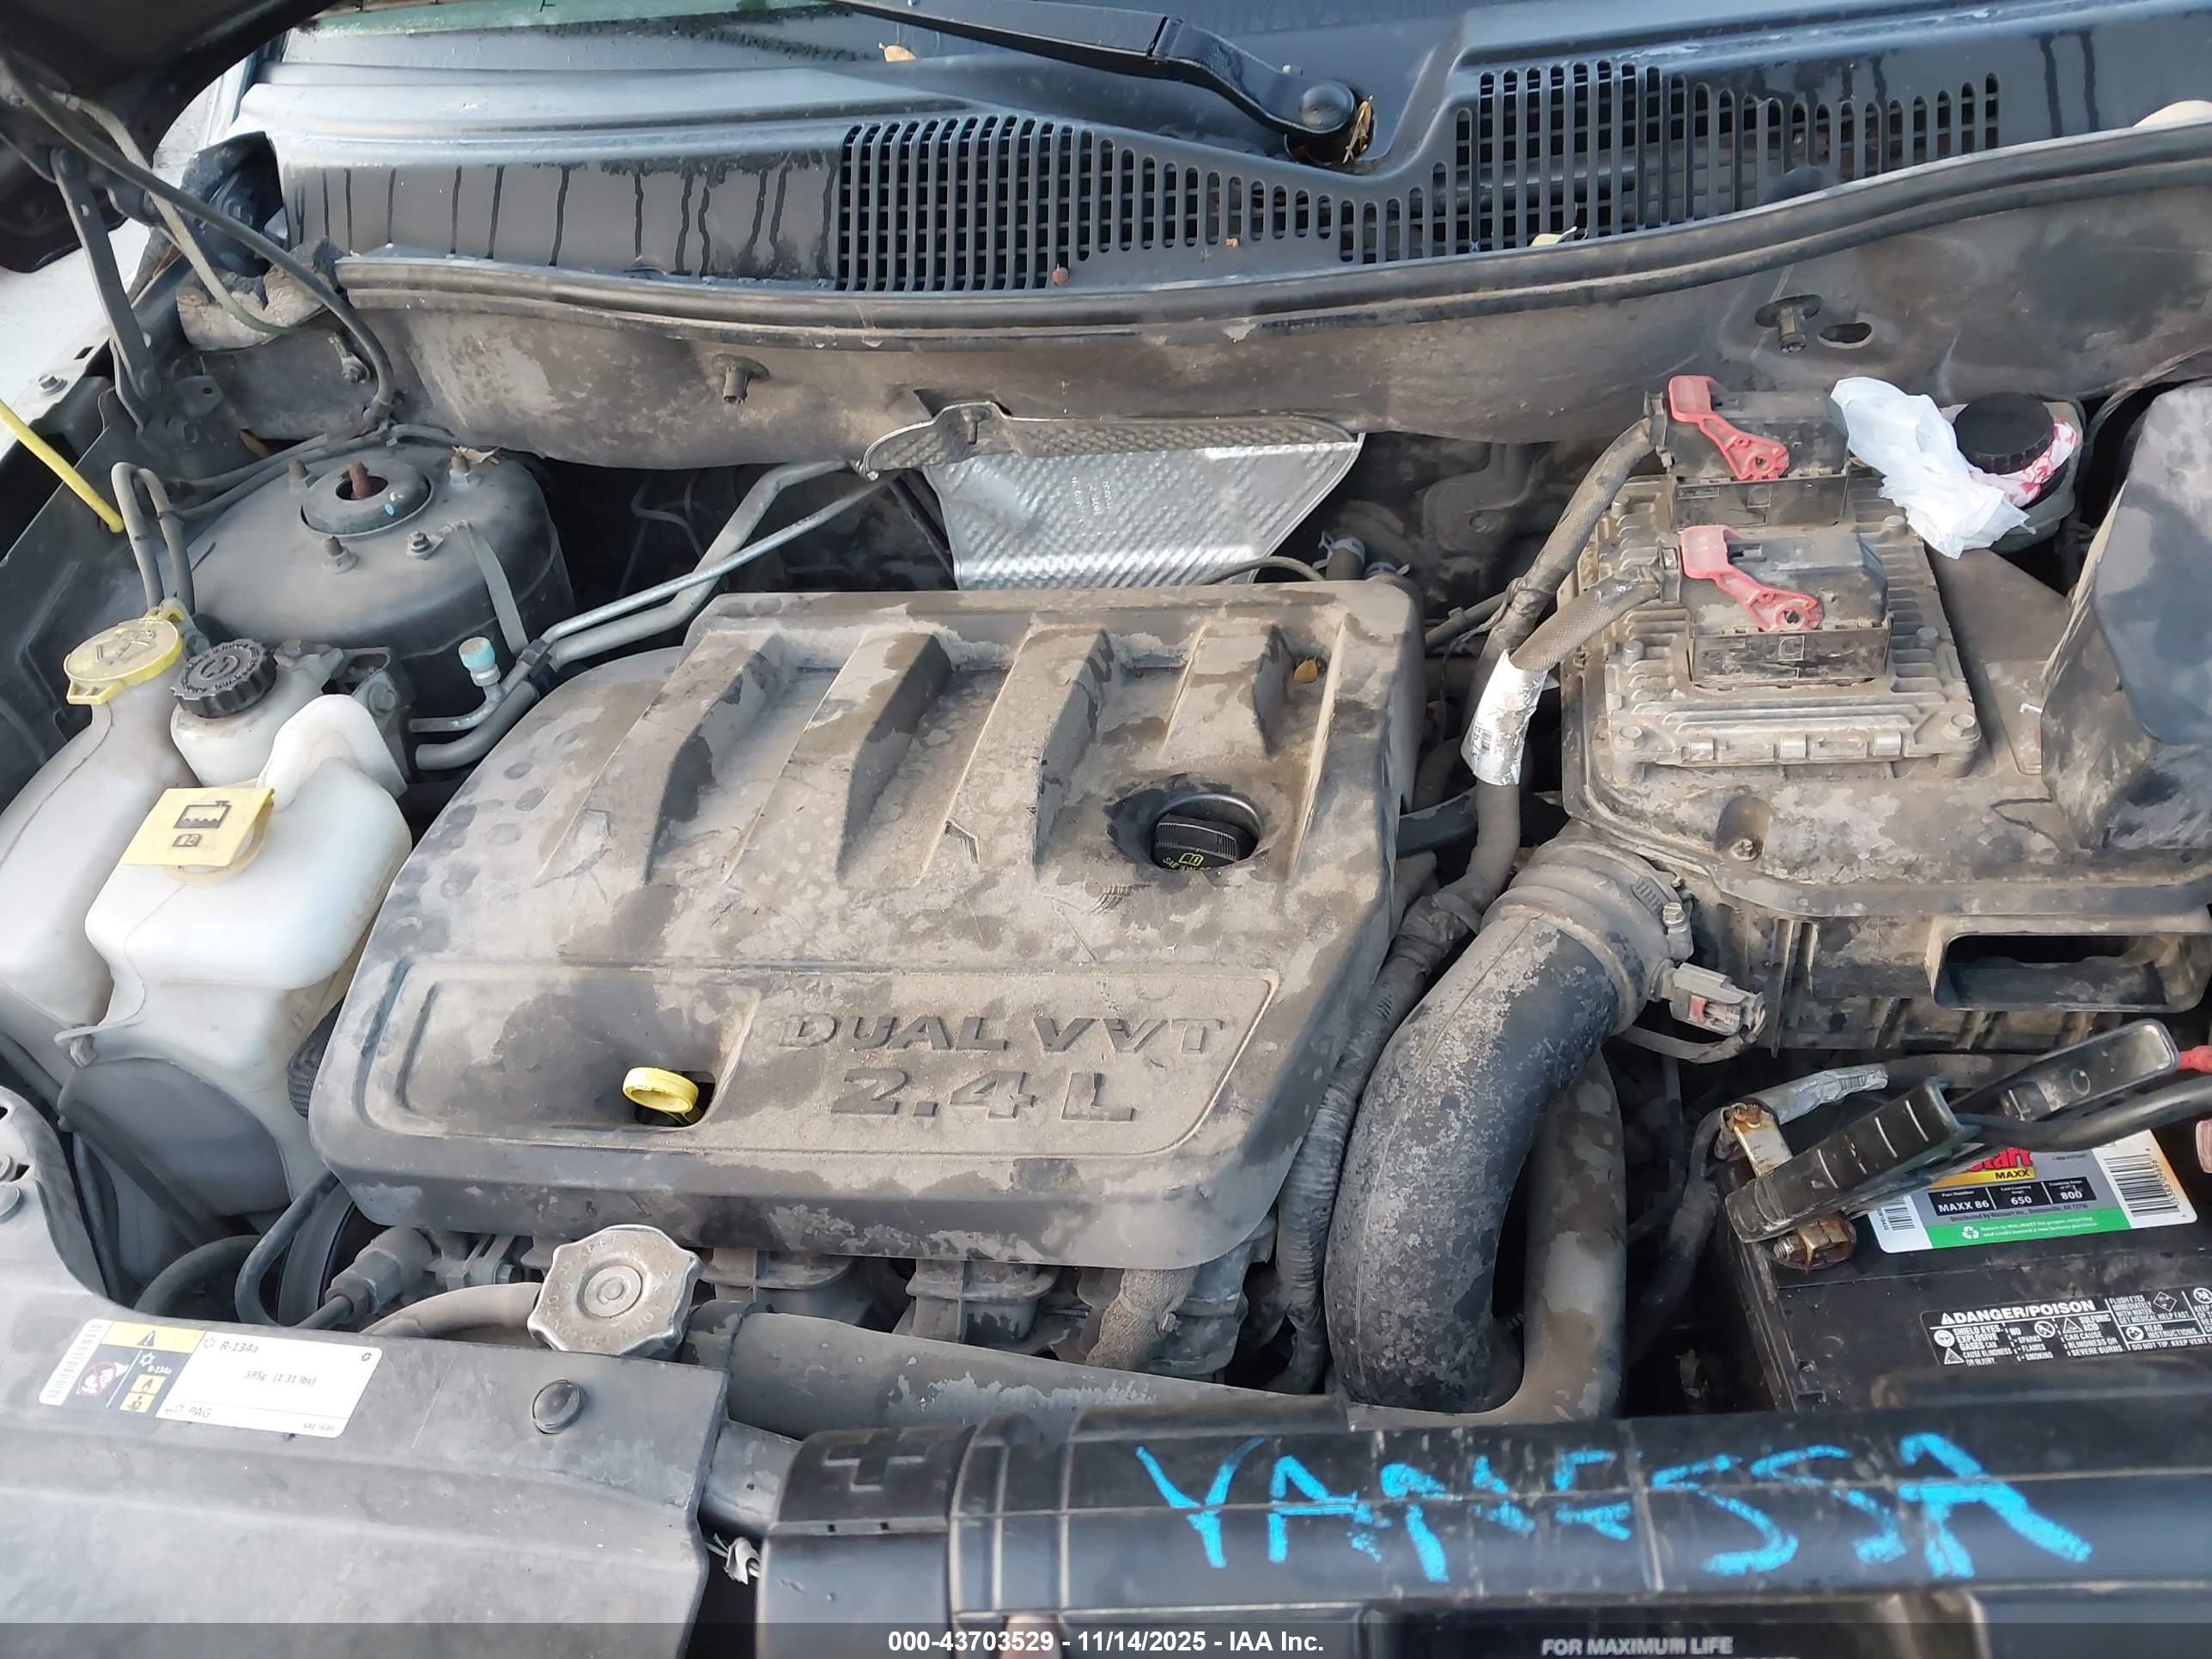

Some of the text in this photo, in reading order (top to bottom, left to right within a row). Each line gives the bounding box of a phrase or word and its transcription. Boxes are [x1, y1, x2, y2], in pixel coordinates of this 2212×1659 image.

[778, 1013, 1224, 1054] DUAL VVT
[1995, 1169, 2031, 1180] MAXX
[2010, 1195, 2033, 1206] 650
[2061, 1190, 2083, 1200] 800
[1938, 1199, 1990, 1212] MAXX 86
[2112, 1300, 2153, 1310] IMMEDIATELY
[2194, 1304, 2210, 1313] KEEP
[1953, 1300, 2096, 1324] DANGER/POISON
[2131, 1314, 2157, 1323] MEDICAL
[2158, 1312, 2173, 1321] HELP
[2078, 1313, 2112, 1325] SULFURIC
[1953, 1327, 1978, 1336] SHIELD
[2010, 1328, 2021, 1336] NO
[2082, 1322, 2100, 1332] ACID
[2143, 1323, 2164, 1332] READ
[1955, 1332, 1999, 1344] EXPLOSIVE
[2018, 1334, 2042, 1343] SPARKS
[2064, 1331, 2104, 1341] CAN CAUSE
[220, 1340, 258, 1354] R-134a
[1959, 1342, 1985, 1352] GASES
[2021, 1343, 2046, 1352] FLAMES
[2068, 1338, 2107, 1349] BLINDNESS
[2142, 1341, 2156, 1350] NOT
[2171, 1339, 2188, 1347] KEEP
[2189, 1337, 2208, 1346] VENT
[1962, 1347, 2013, 1358] CAUSE BLINDNESS
[2025, 1351, 2054, 1361] SMOKING
[2071, 1346, 2100, 1357] SEVERE
[147, 1365, 173, 1375] R-134a
[187, 1405, 212, 1419] PAG
[1542, 1636, 1734, 1656] FOR MAXIMUM LIFE
